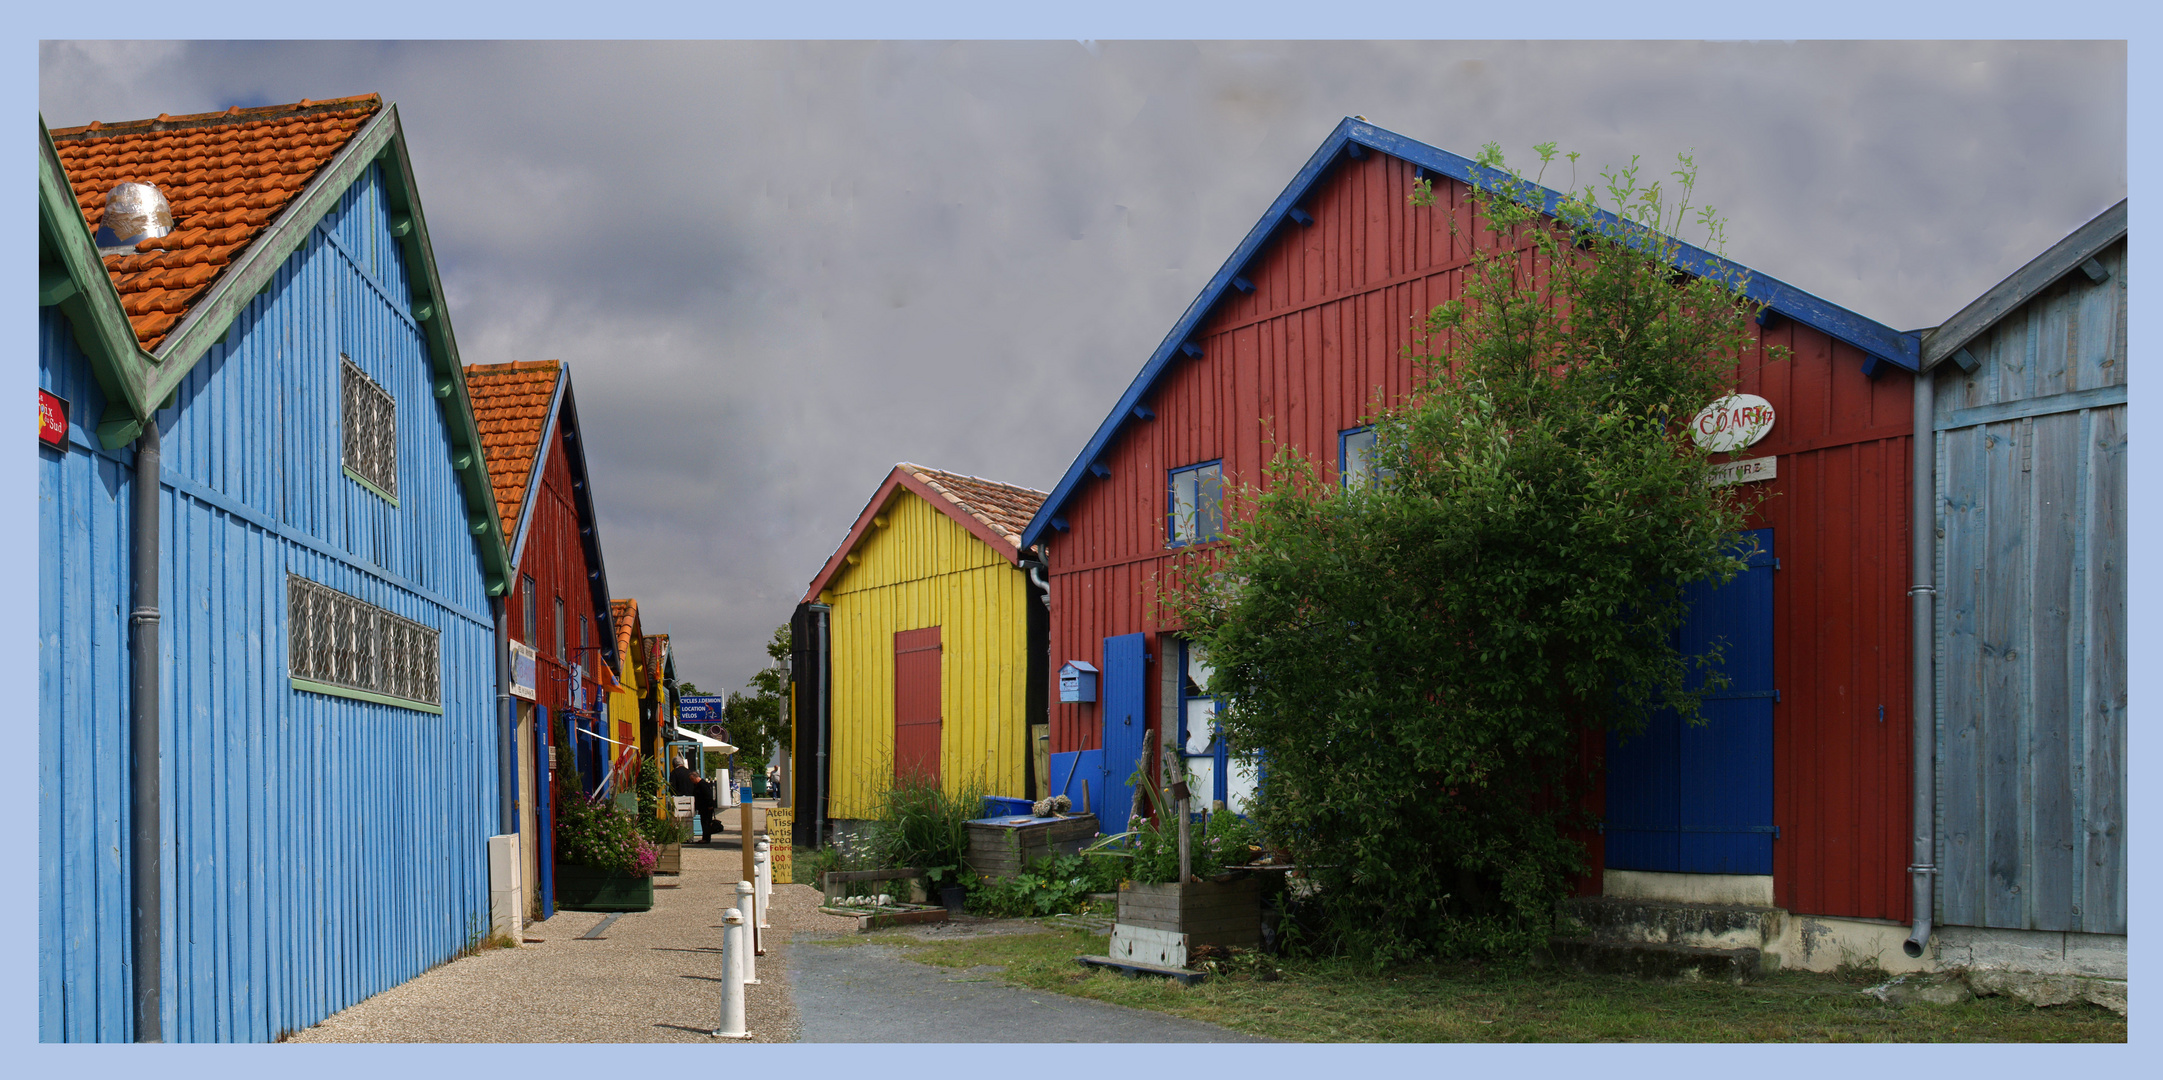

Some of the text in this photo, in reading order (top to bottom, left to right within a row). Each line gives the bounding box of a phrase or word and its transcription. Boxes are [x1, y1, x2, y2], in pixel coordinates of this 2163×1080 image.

[50, 418, 62, 433] Sud
[767, 808, 792, 817] Atelie
[773, 819, 792, 827] Tiss
[768, 828, 792, 836] Artis
